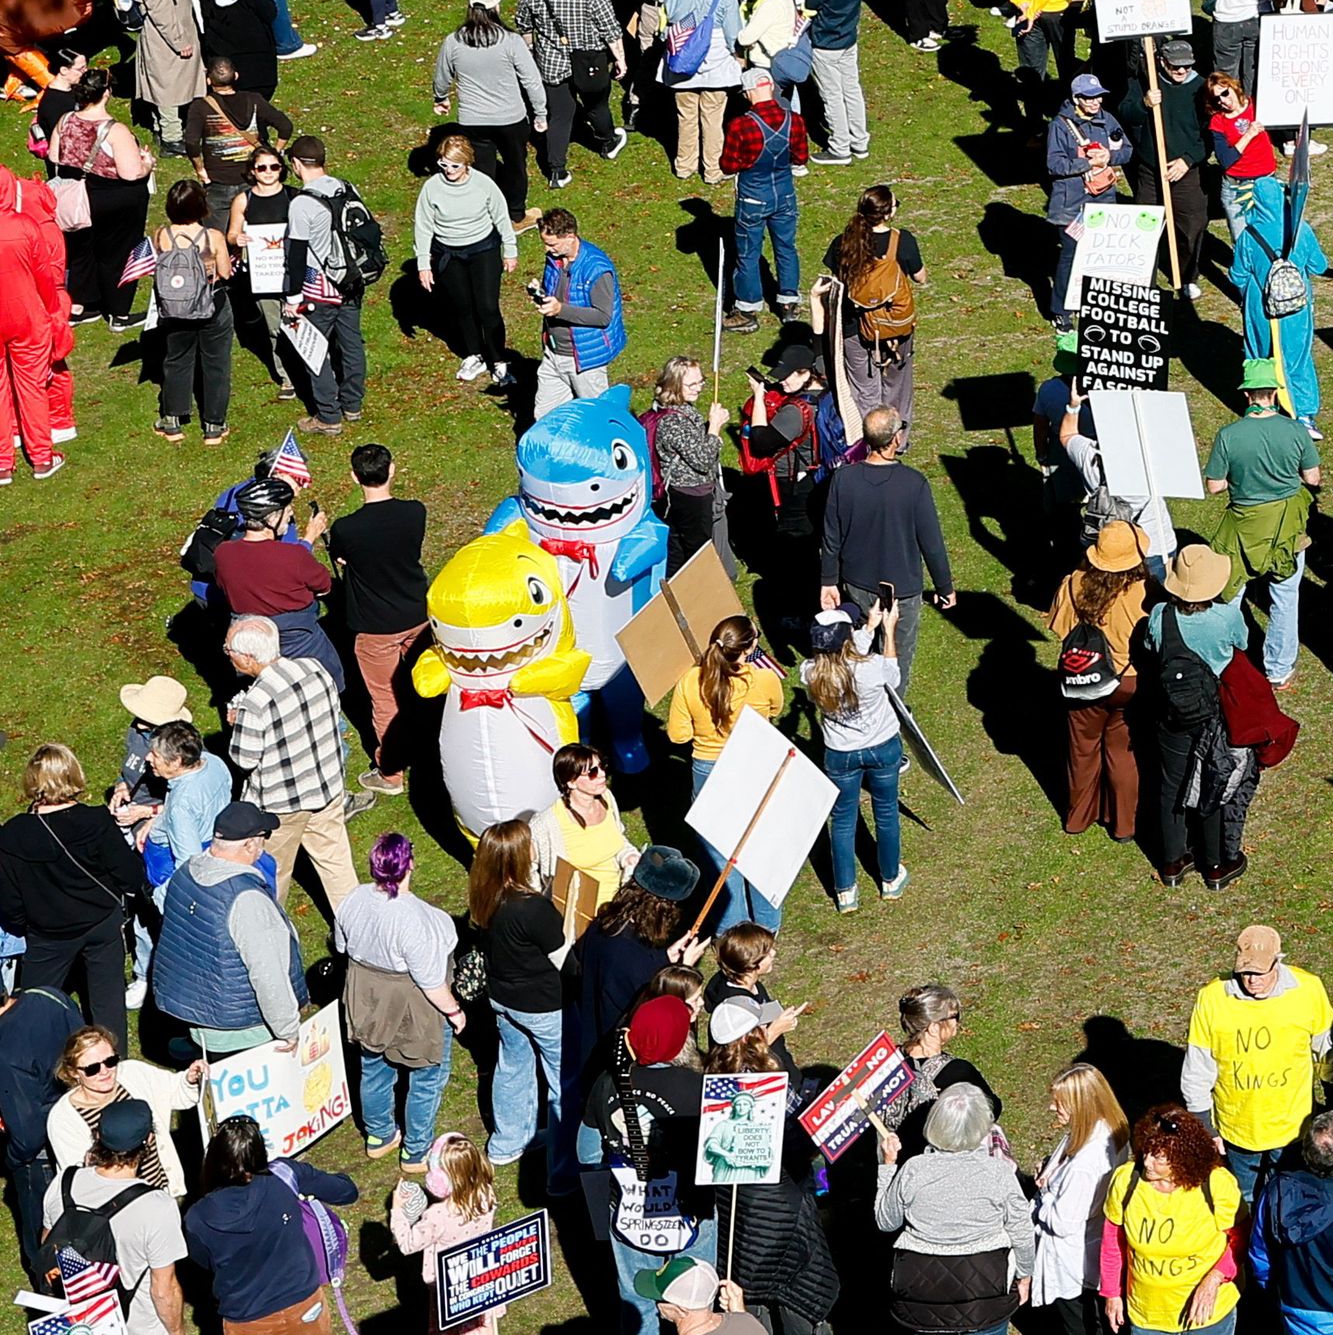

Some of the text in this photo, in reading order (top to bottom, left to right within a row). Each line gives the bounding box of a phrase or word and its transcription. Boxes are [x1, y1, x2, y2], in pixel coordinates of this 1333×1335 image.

[1115, 5, 1135, 16] NOT
[1272, 23, 1330, 41] HUMAN
[1272, 43, 1329, 61] RIGHTS
[1271, 59, 1330, 76] BELONG
[1281, 74, 1326, 89] EVERY
[1285, 89, 1318, 104] ONE
[1105, 213, 1131, 231] NO
[1092, 232, 1141, 251] DICK
[1085, 251, 1146, 267] TATORS
[1089, 277, 1161, 304] MISSING
[1086, 292, 1161, 319] COLLEGE
[1080, 305, 1169, 336] FOOTBALL
[1109, 329, 1133, 346] TO
[1080, 345, 1164, 369] STAND UP
[1085, 361, 1157, 384] AGAINST
[1236, 1025, 1272, 1055] NO
[211, 1062, 270, 1104] YOU
[1233, 1060, 1293, 1091] KINGS
[620, 1183, 673, 1200] WHAT
[620, 1201, 673, 1215] WOULD
[619, 1216, 687, 1233] SPRINGSTEEN
[1138, 1217, 1176, 1245] NO
[490, 1224, 539, 1254] PEOPLE
[639, 1234, 670, 1248] DO
[446, 1252, 499, 1288] WILL
[470, 1253, 541, 1289] COWARDS
[494, 1263, 541, 1298] QUIET
